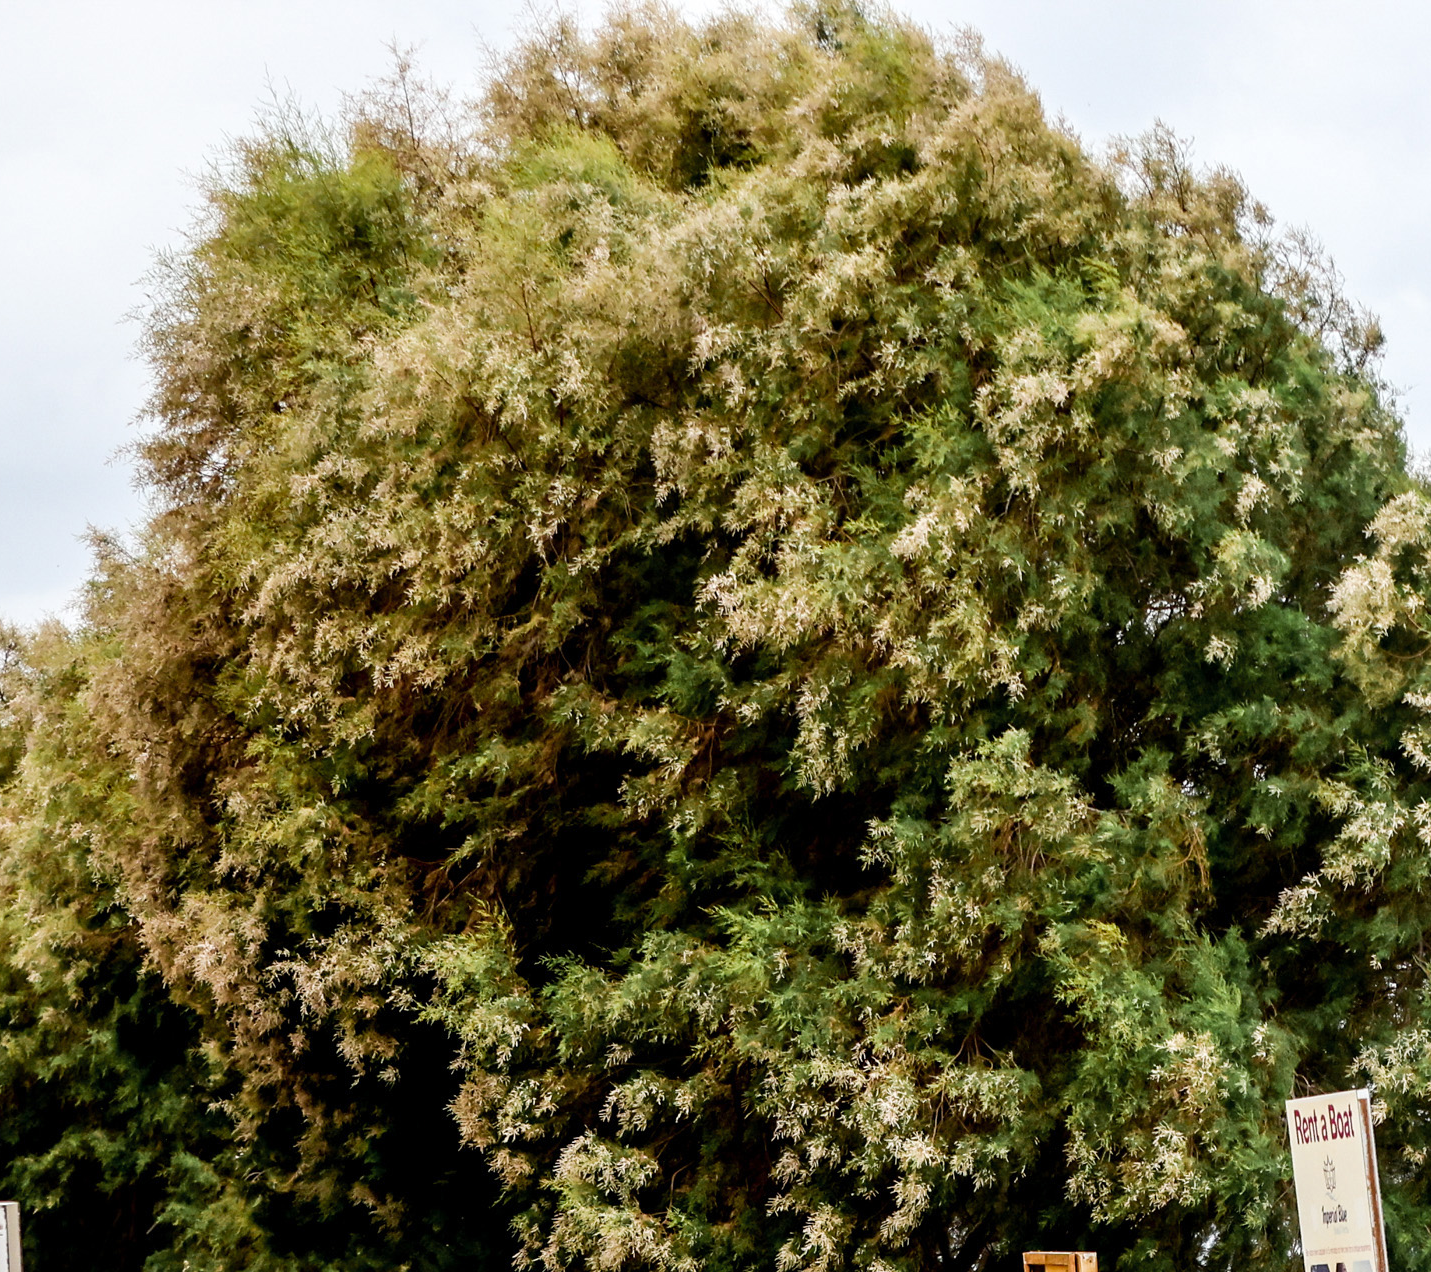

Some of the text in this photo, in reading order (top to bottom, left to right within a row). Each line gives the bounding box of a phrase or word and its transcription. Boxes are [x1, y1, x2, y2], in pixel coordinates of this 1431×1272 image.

[1294, 1104, 1355, 1145] Rent a Boat
